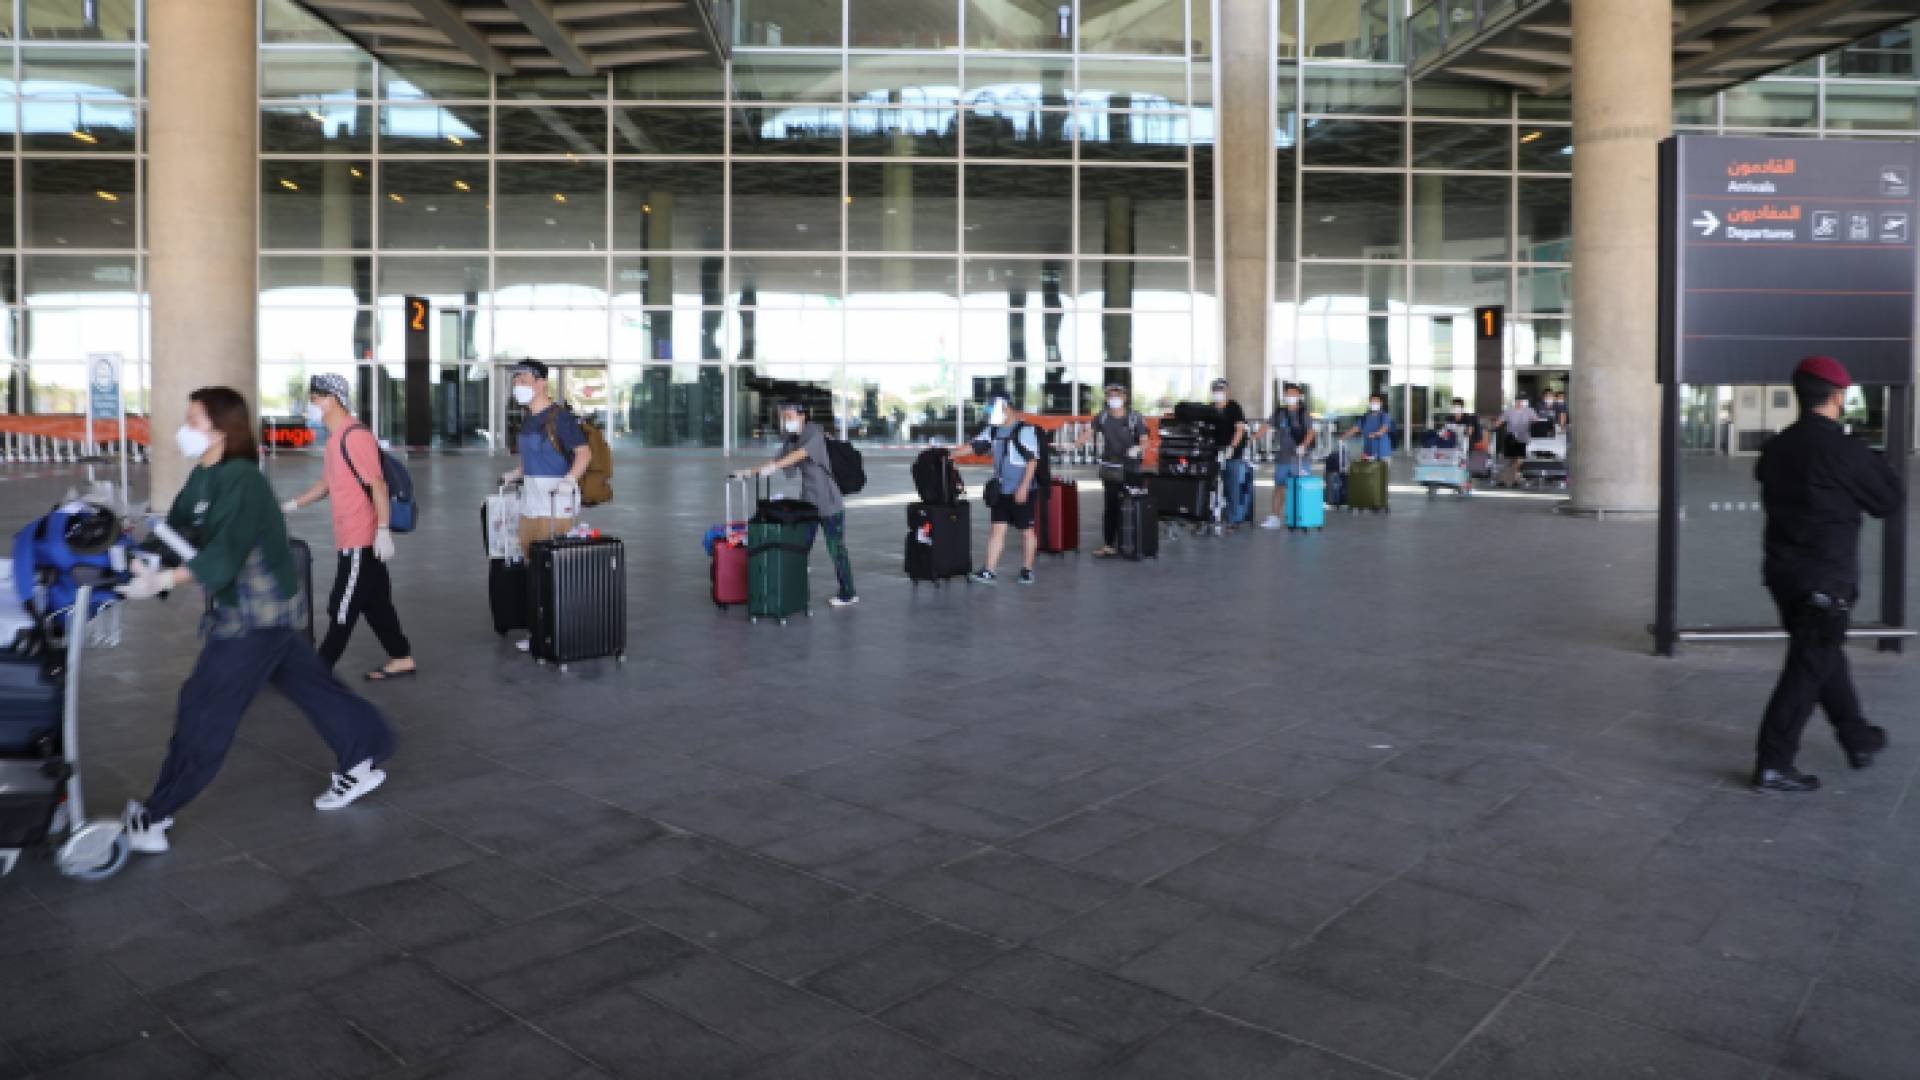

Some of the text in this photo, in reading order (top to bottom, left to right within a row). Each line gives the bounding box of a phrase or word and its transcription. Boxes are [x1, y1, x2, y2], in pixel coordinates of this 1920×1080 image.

[1726, 158, 1796, 177] القادمون
[1727, 180, 1775, 193] Arrivals
[1726, 203, 1801, 223] المغادرون
[1726, 226, 1795, 240] Departures
[411, 301, 425, 330] 2
[1483, 311, 1493, 336] 1
